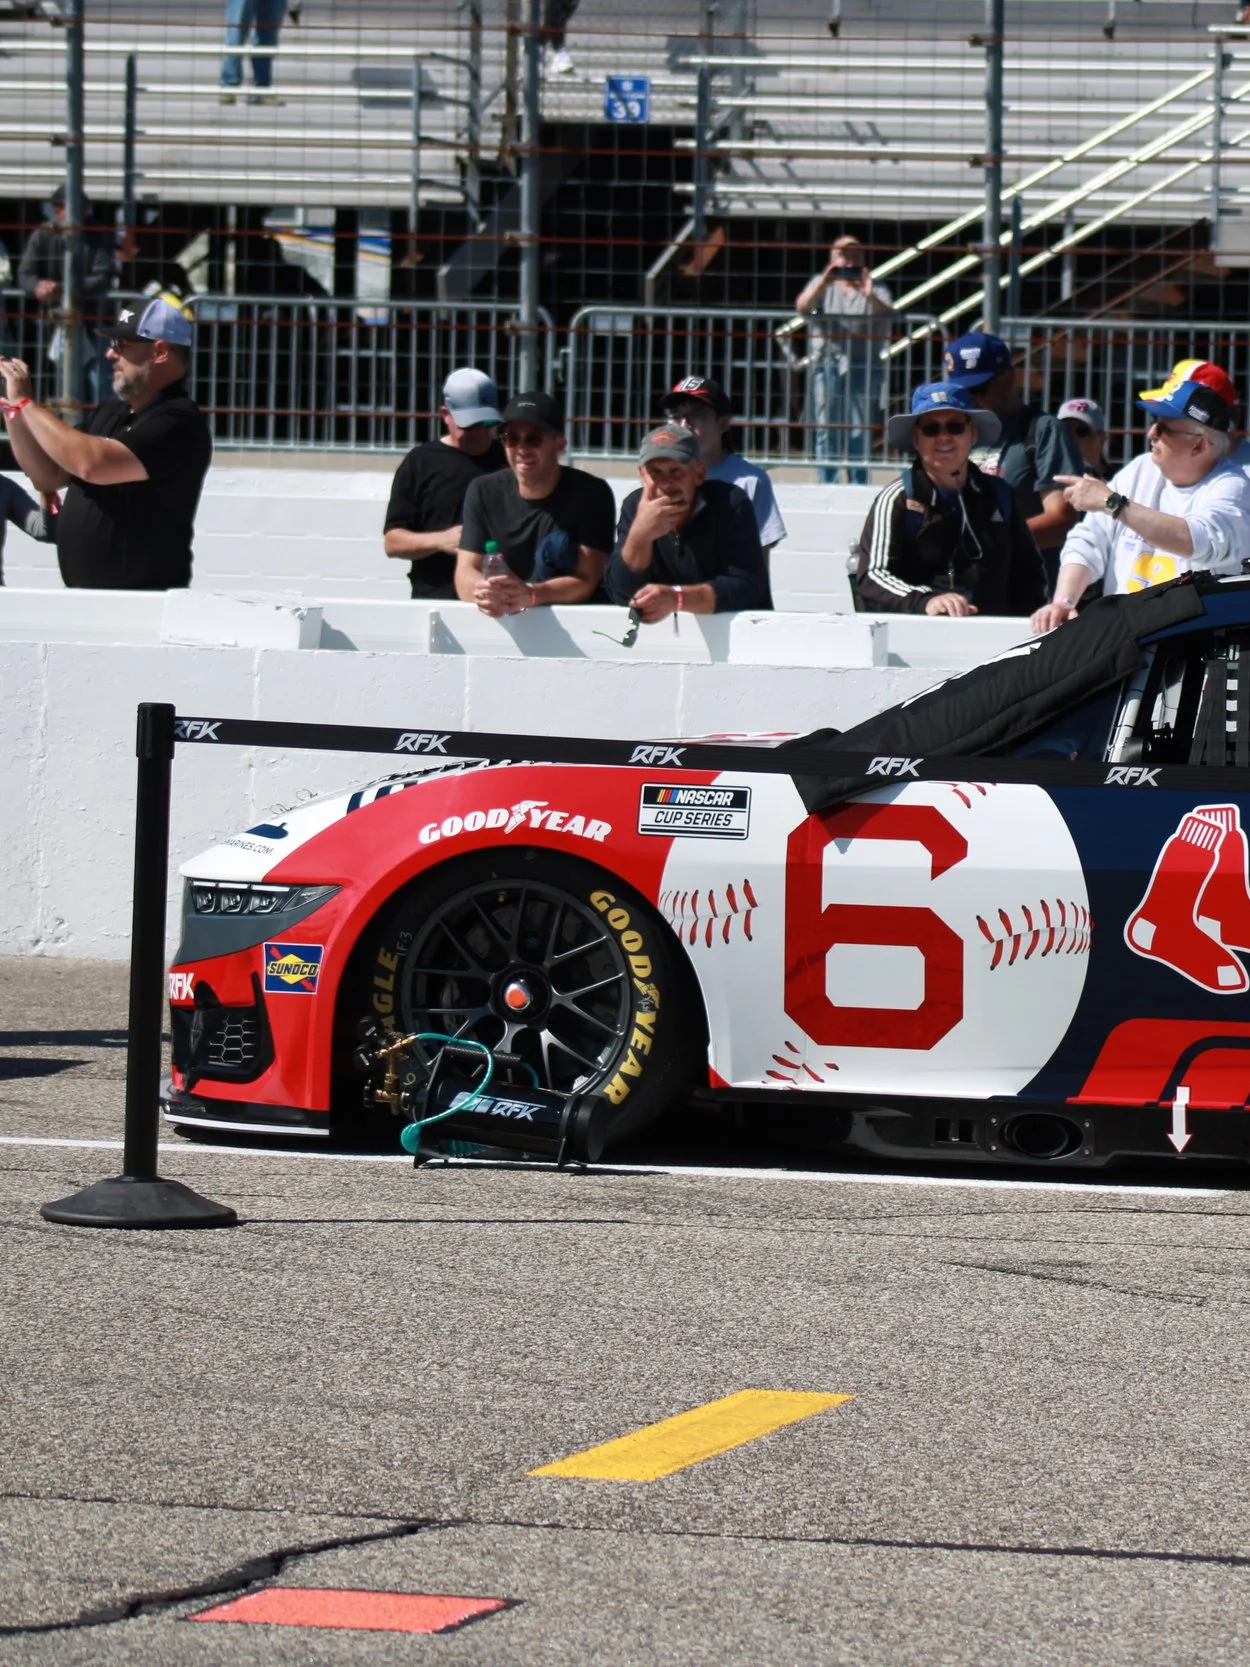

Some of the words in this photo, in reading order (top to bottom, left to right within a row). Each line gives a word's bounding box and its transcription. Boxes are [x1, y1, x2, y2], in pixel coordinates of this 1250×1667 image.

[612, 101, 641, 119] 39
[393, 732, 452, 754] RFK
[628, 745, 687, 767] RFK
[865, 756, 925, 778] RFK
[1103, 765, 1163, 787] RFK
[675, 788, 734, 806] NASCAR
[418, 800, 612, 845] GOODYEAR
[654, 810, 683, 825] CUP
[684, 811, 734, 828] SERIES
[221, 838, 275, 856] MARINES.COM
[784, 803, 969, 1051] 6
[268, 962, 318, 977] SUNOCO
[169, 972, 195, 1000] RFK
[373, 946, 399, 1034] AGLE
[589, 889, 661, 1105] GOODYEAR
[491, 1101, 542, 1122] RFK
